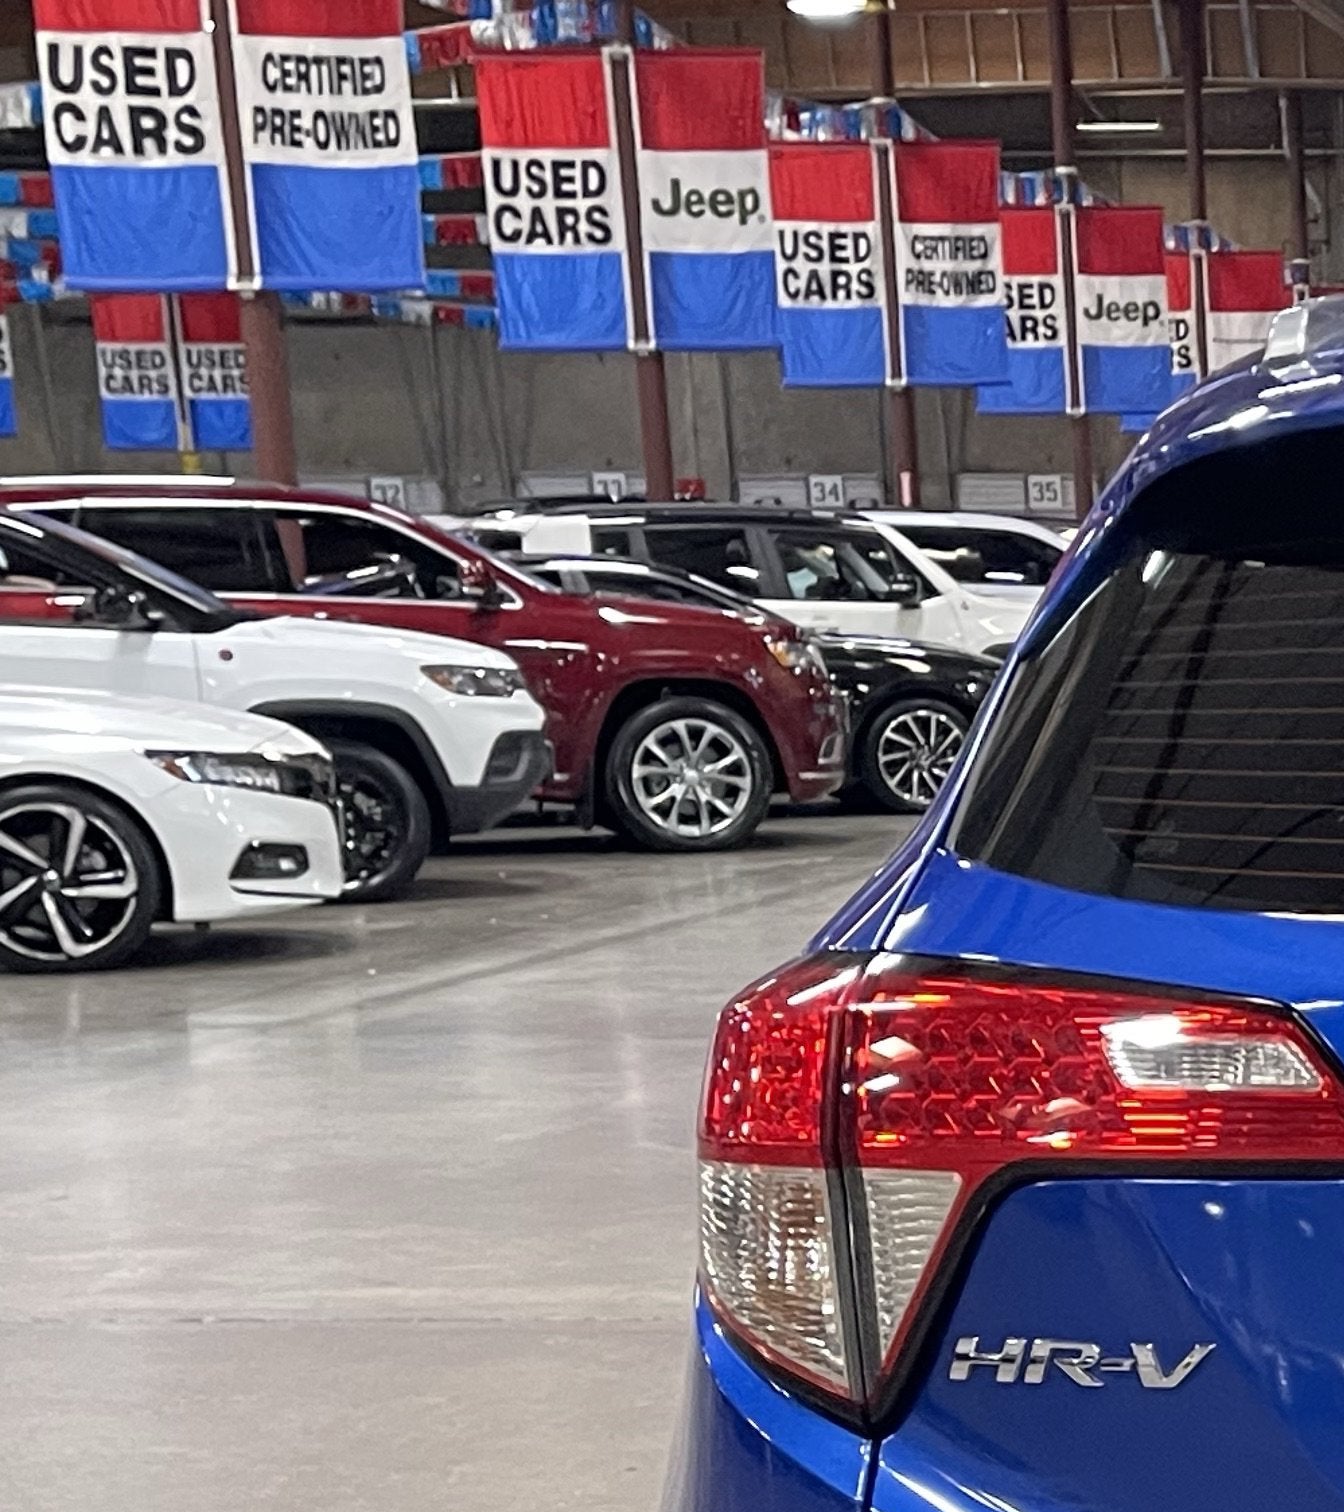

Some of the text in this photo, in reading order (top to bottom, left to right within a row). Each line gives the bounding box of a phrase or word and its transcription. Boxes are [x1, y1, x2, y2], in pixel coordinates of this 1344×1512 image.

[47, 43, 197, 97] USED
[261, 52, 385, 95] CERTIFIED
[53, 102, 206, 157] CARS
[252, 106, 400, 151] PRE-OWNED
[491, 157, 607, 200] USED
[651, 177, 760, 226] Jeep
[493, 203, 613, 246] CARS
[778, 229, 872, 264] USED
[911, 234, 989, 261] CERTIFIED
[781, 266, 875, 301] CARS
[904, 267, 996, 297] PRE-OWNED
[1083, 293, 1161, 327] Jeep
[101, 348, 166, 370] USED
[104, 373, 170, 395] CARS
[812, 481, 840, 503] 34
[1032, 481, 1059, 503] 35
[949, 1336, 1217, 1388] HR-V
